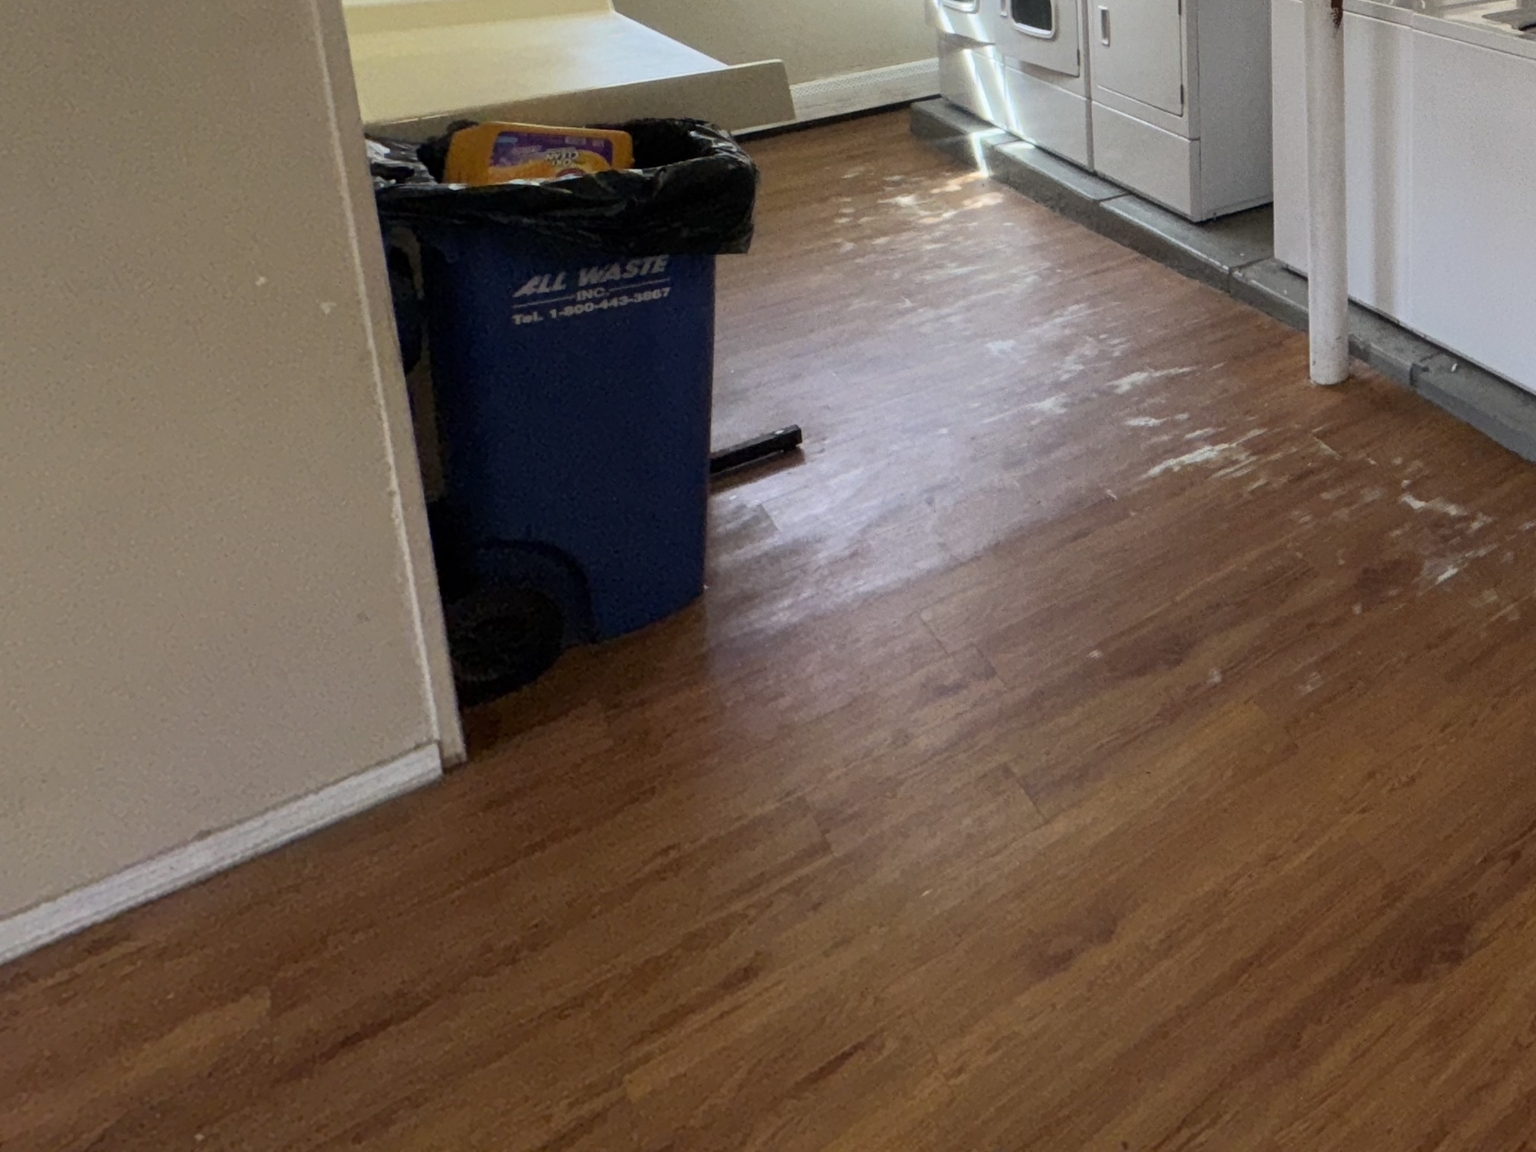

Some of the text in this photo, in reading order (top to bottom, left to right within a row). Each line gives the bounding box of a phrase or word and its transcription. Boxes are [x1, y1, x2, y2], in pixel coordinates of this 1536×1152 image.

[544, 151, 579, 162] CLEAN
[512, 254, 669, 298] ALL WASTE
[575, 287, 610, 301] INC.
[512, 311, 543, 325] Tel.
